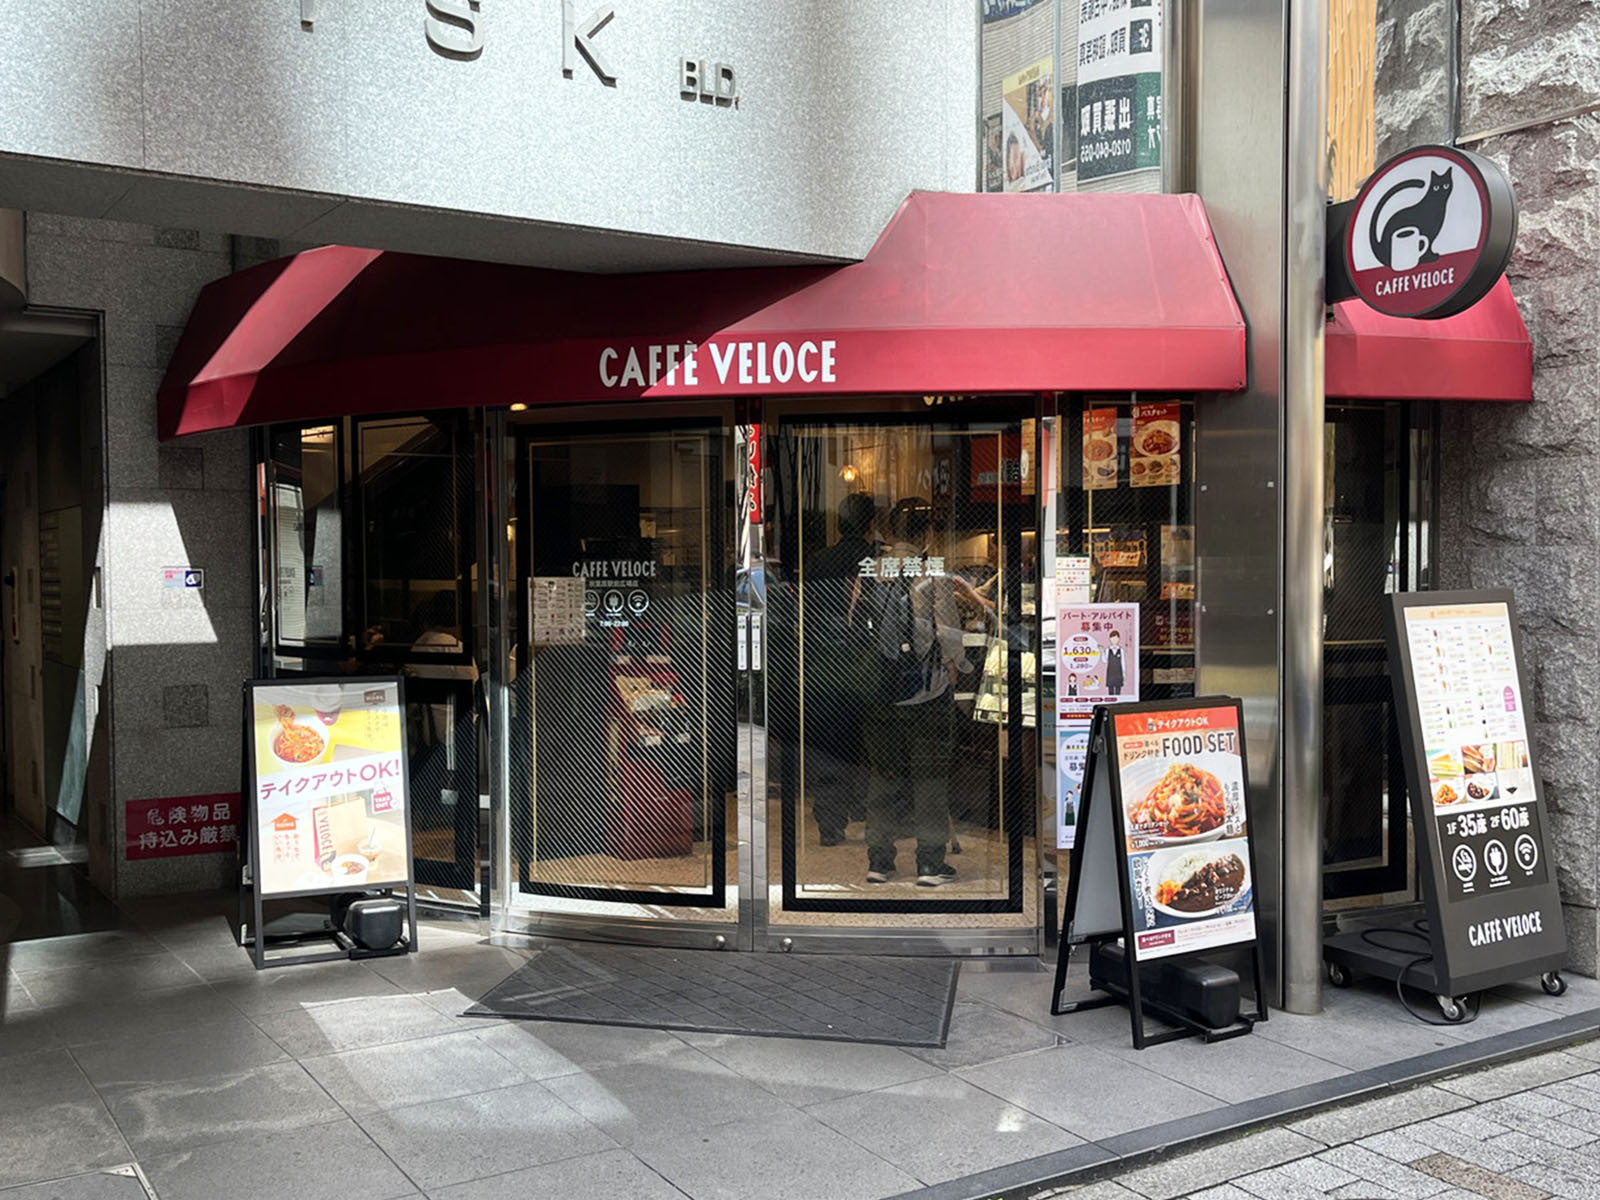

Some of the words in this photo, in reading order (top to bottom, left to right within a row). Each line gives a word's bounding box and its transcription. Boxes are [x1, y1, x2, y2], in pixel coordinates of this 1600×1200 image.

[1412, 267, 1455, 290] VELOCE
[599, 340, 698, 388] CAFFÈ
[708, 340, 837, 385] VELOCE
[611, 560, 657, 577] VELOCE
[858, 556, 946, 578] 全席禁煙
[1081, 621, 1114, 632] 募集中
[1162, 734, 1203, 758] FOOD
[1207, 731, 1235, 753] SET
[260, 759, 400, 800] テイクアウトOK!
[147, 803, 231, 826] 危険物品
[1502, 911, 1543, 939] VELOCE
